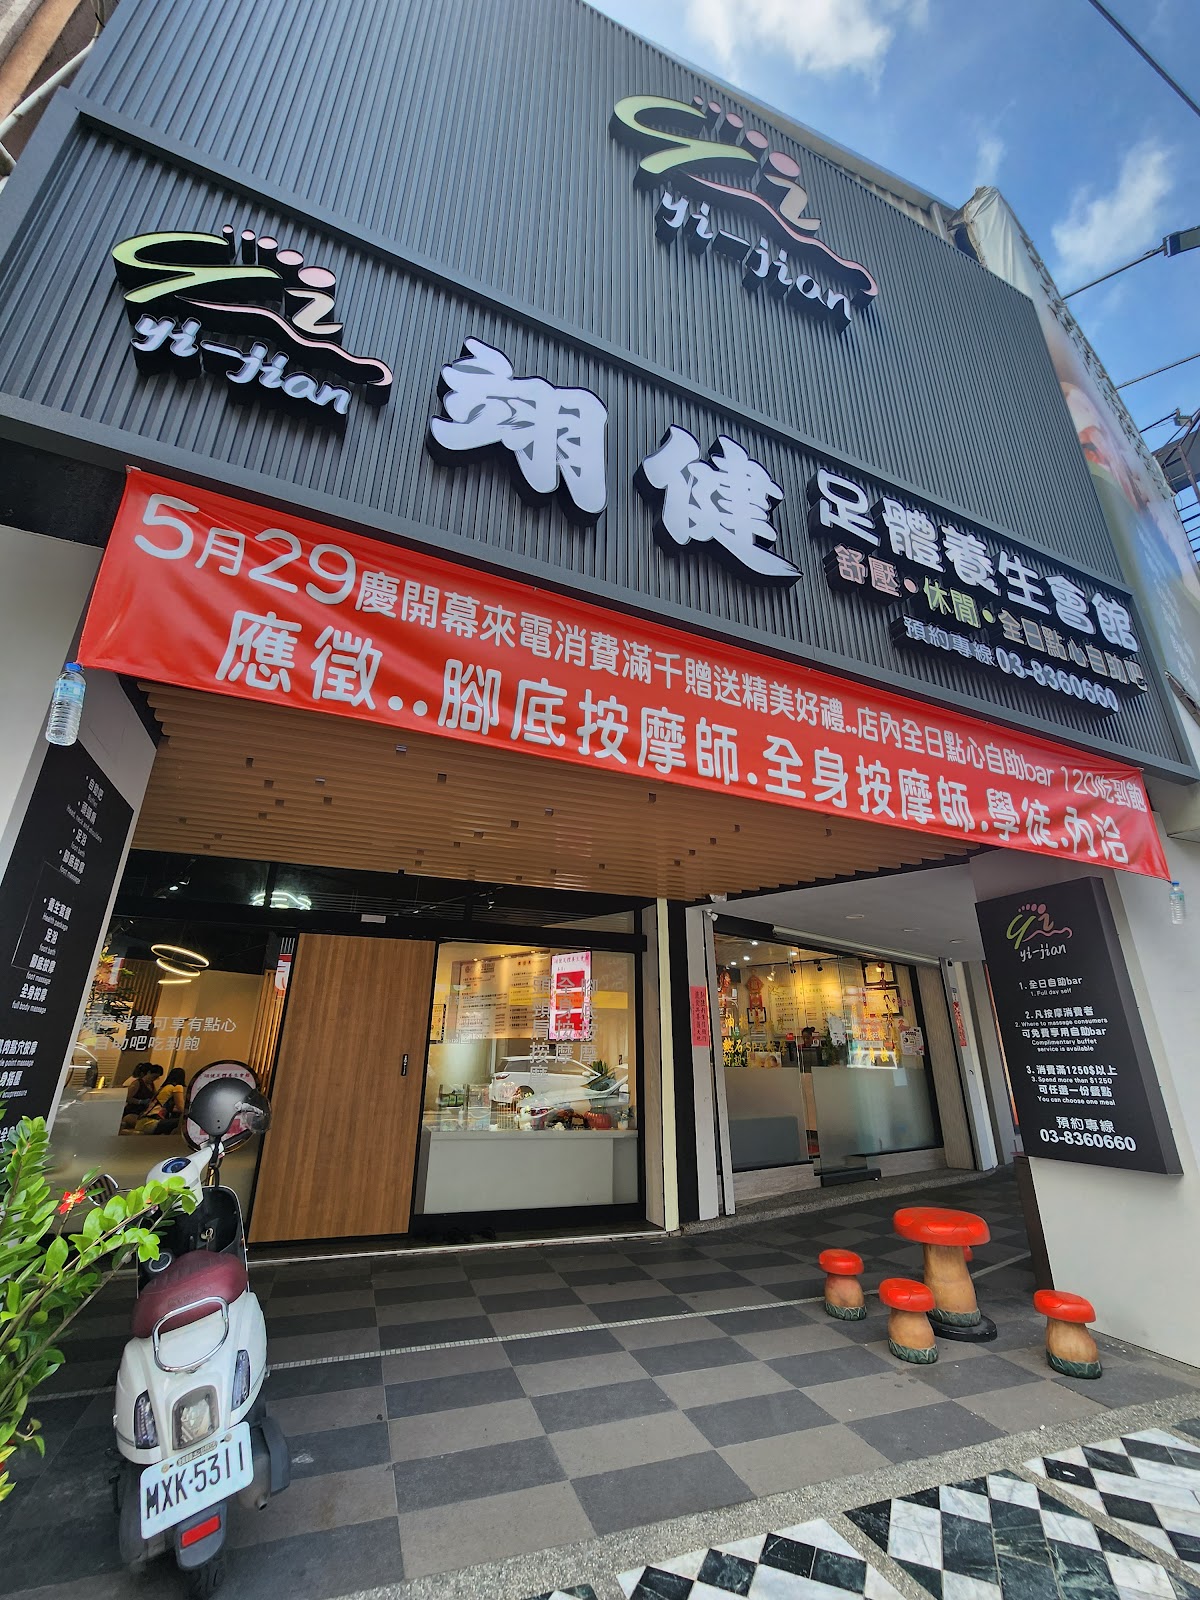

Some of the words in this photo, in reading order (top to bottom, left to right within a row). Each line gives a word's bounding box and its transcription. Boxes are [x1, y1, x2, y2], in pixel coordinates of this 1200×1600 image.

[661, 192, 853, 321] yi-jian
[134, 313, 352, 415] yi-jian
[817, 467, 1139, 654] 足體養生會館
[1020, 943, 1067, 962] yi-jian
[20, 983, 48, 1003] 全身按摩
[1036, 1044, 1059, 1052] service
[1076, 1037, 1098, 1045] buffet
[1089, 1077, 1113, 1085] $1250
[1037, 1095, 1051, 1103] You
[1062, 1096, 1086, 1105] choose
[1056, 1116, 1116, 1134] 預約專線
[1039, 1128, 1137, 1152] 03-8360660
[145, 1441, 245, 1520] MXK-5311
